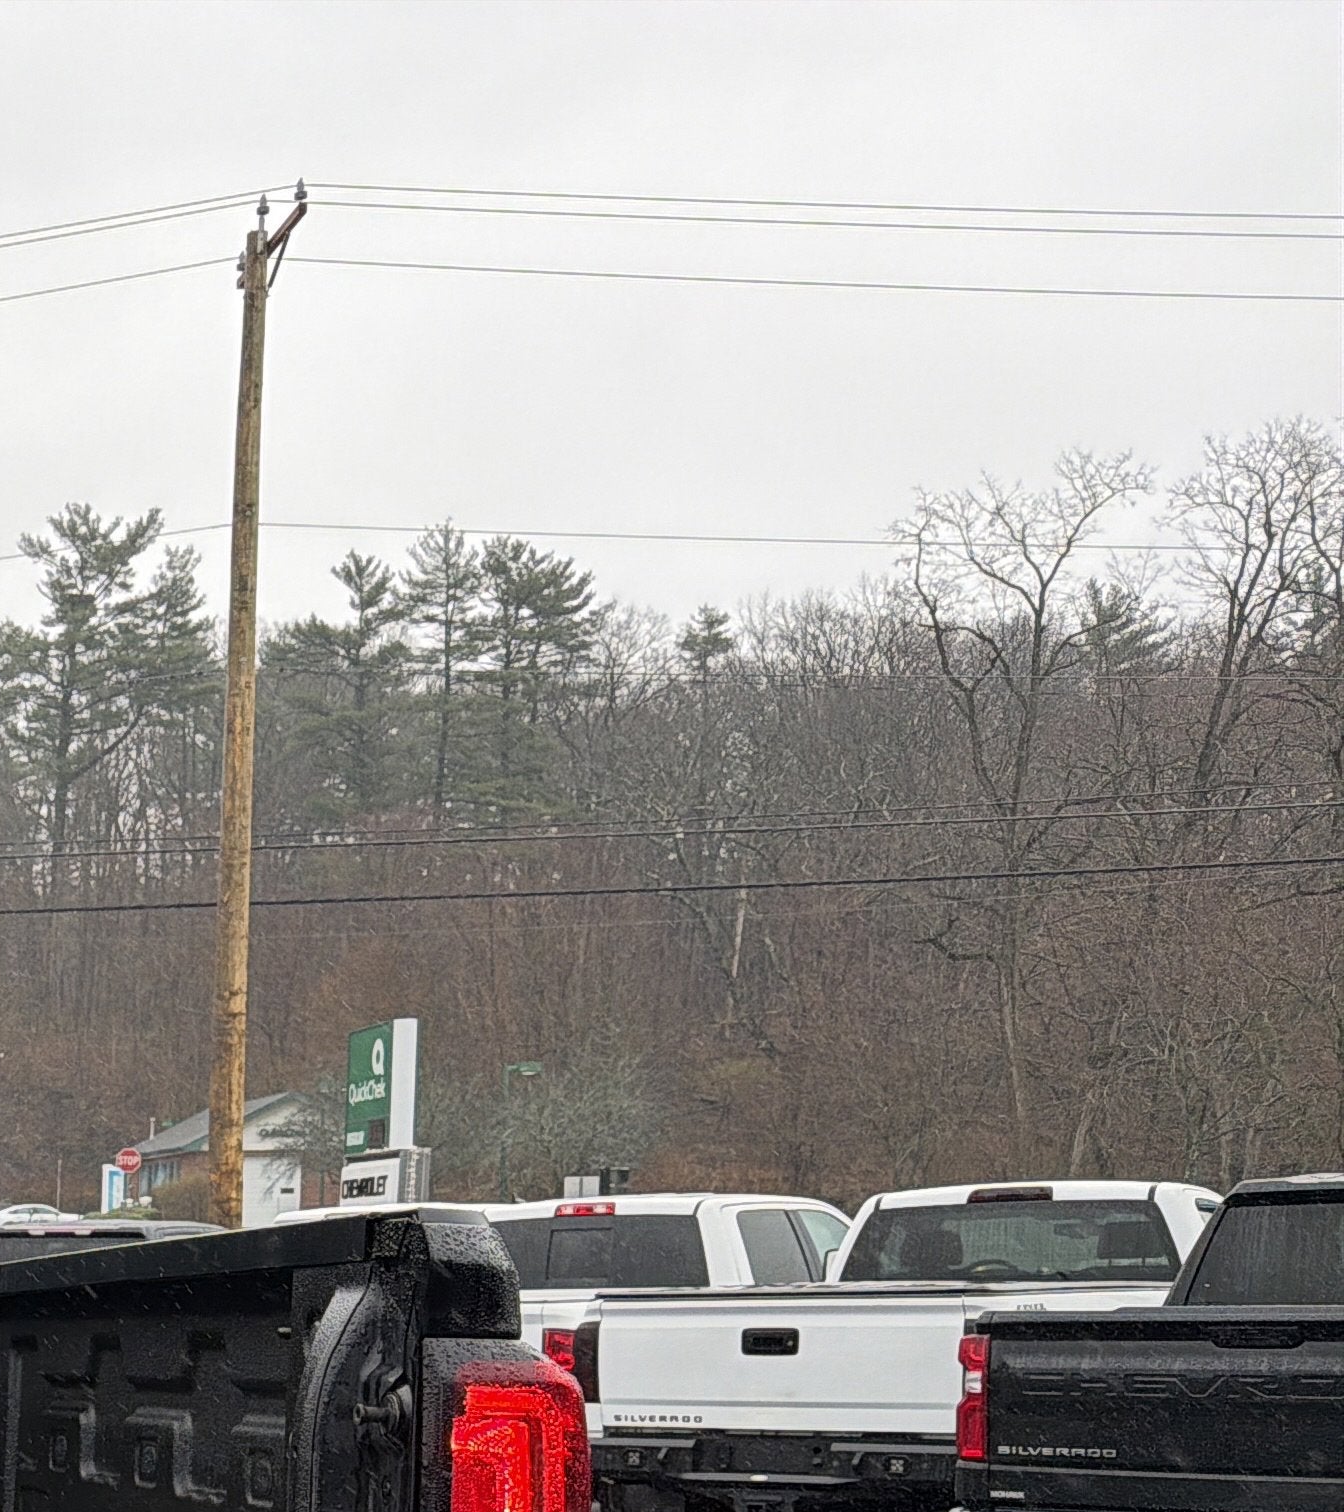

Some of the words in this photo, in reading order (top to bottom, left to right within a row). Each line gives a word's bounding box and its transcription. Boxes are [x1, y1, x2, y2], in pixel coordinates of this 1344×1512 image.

[118, 1155, 139, 1166] STOP
[1022, 1373, 1344, 1399] CHEVRO
[613, 1414, 703, 1424] SILVERADO
[997, 1445, 1117, 1458] SILVERADO
